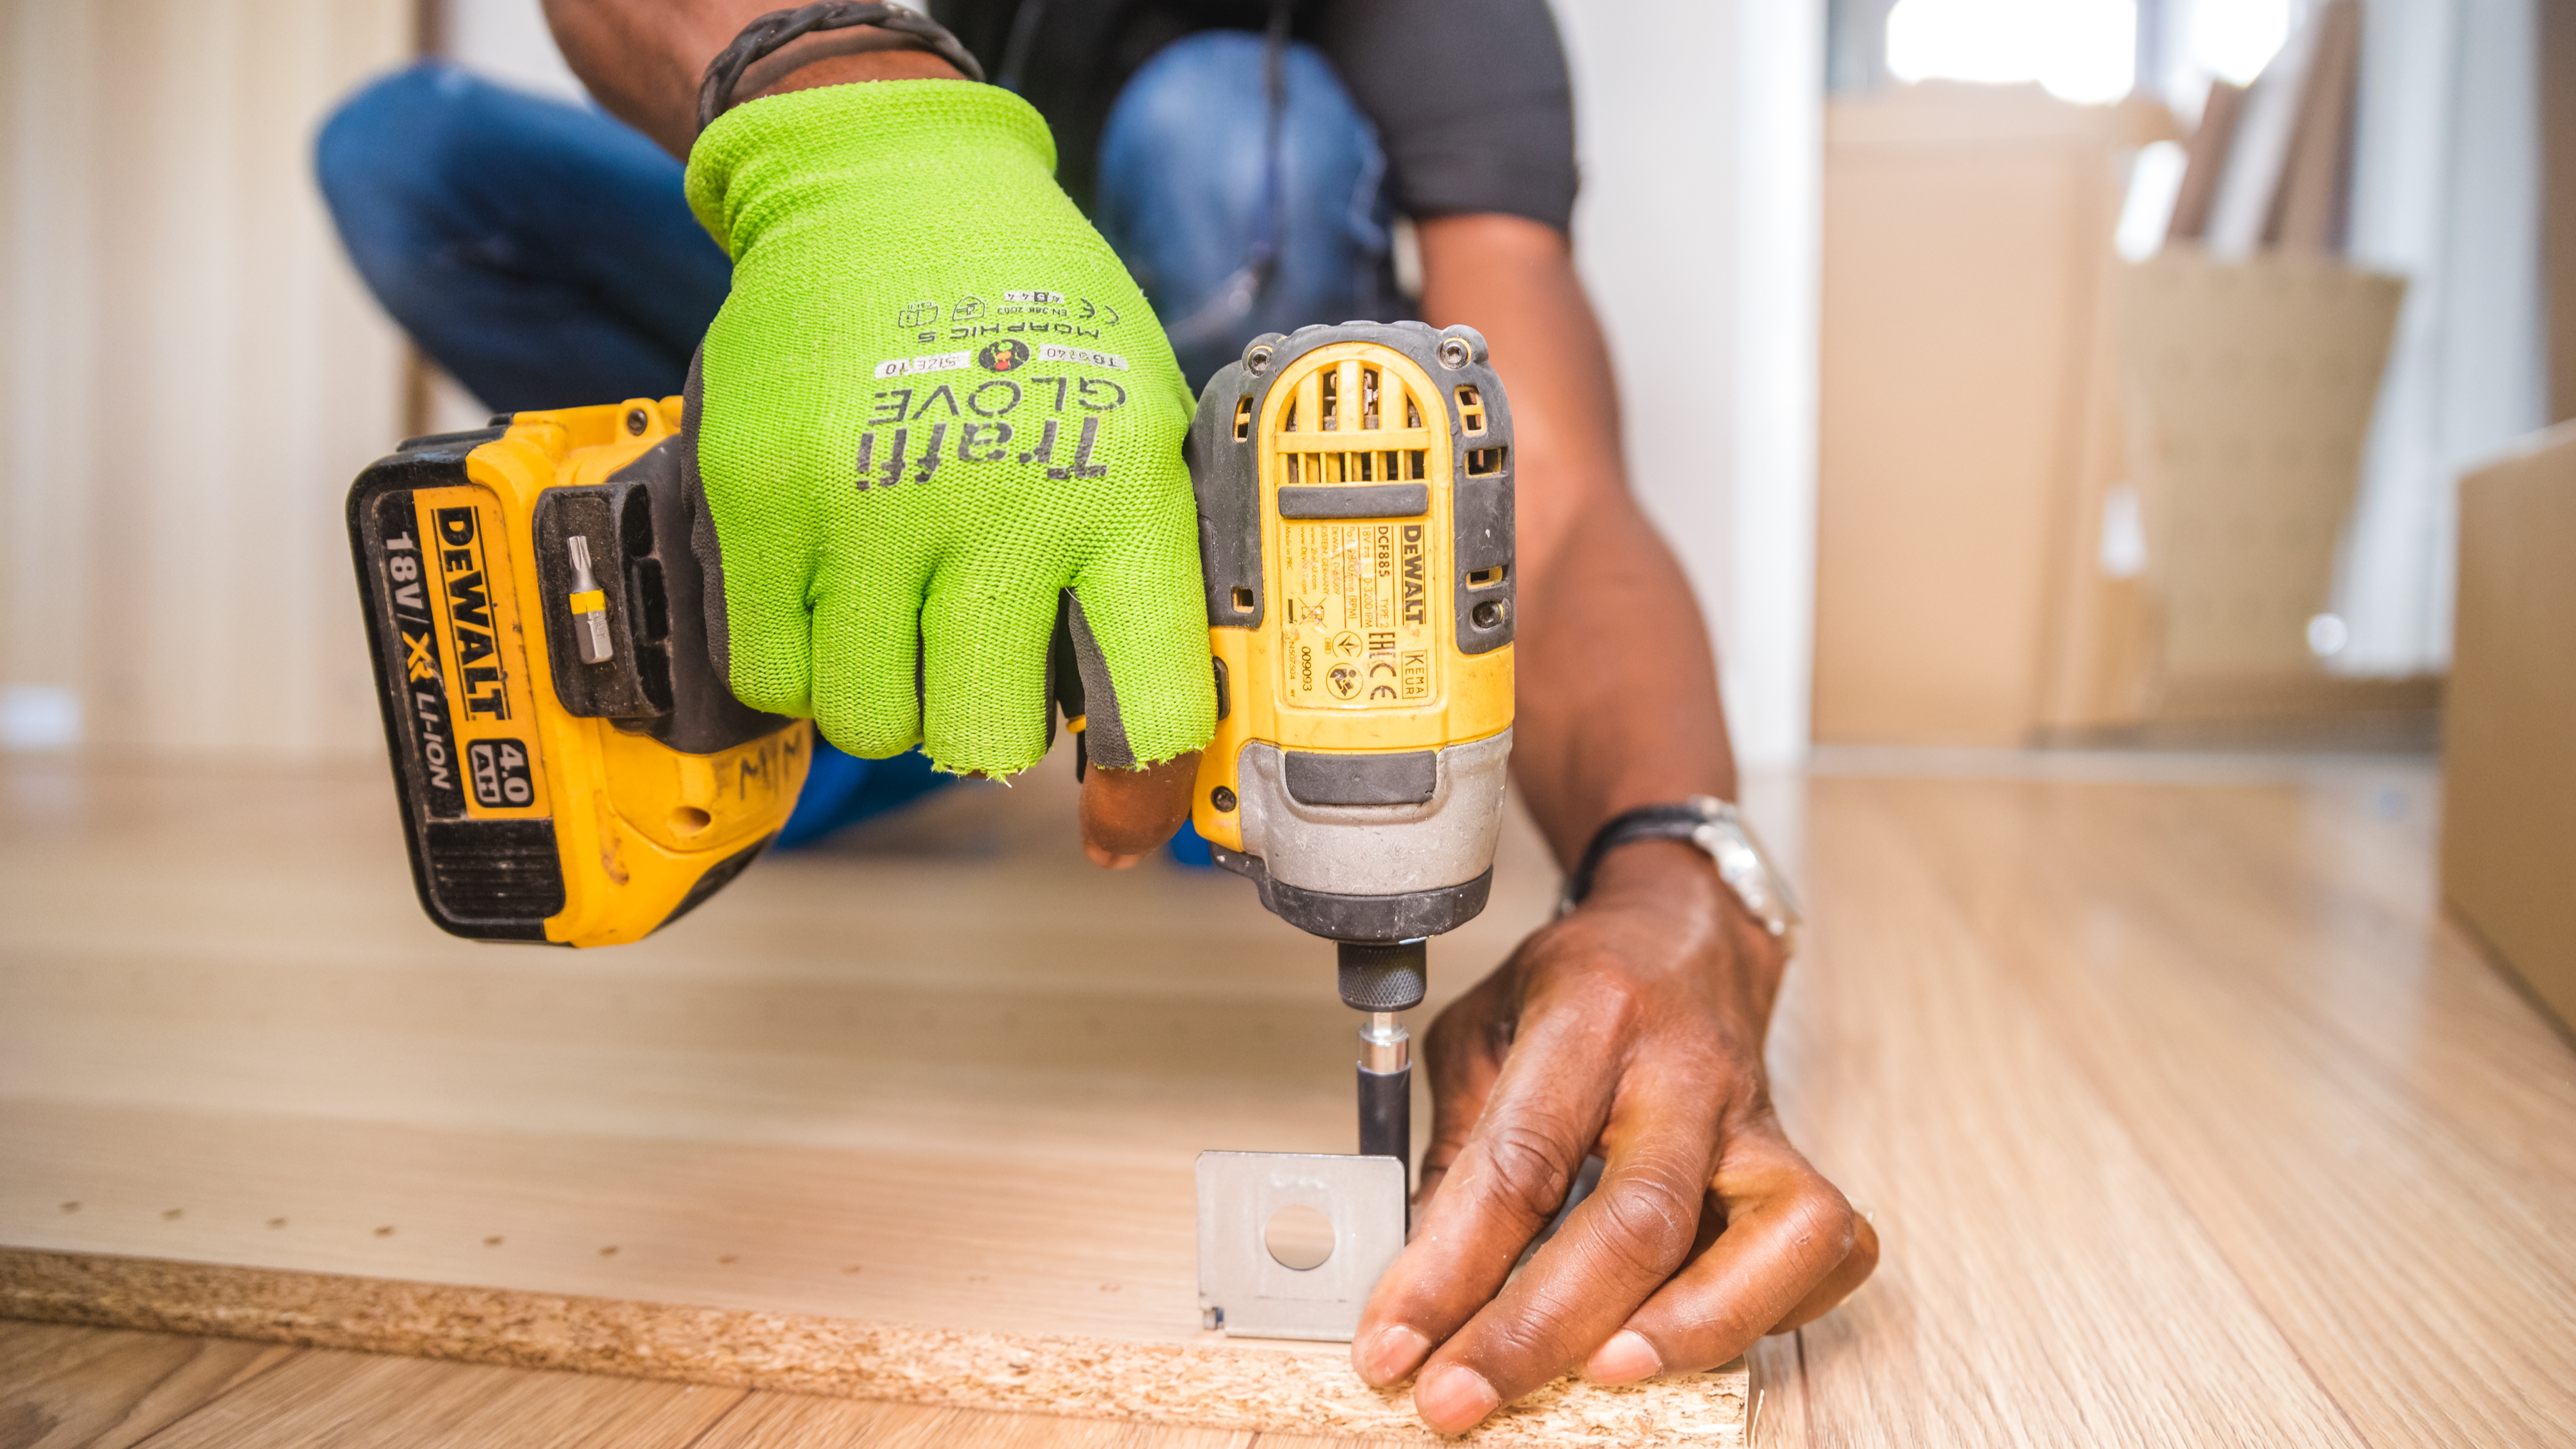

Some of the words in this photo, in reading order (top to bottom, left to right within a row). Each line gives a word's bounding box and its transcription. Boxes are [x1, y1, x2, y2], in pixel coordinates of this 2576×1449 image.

[886, 362, 910, 376] 10
[917, 356, 955, 371] SIZE
[868, 376, 1126, 426] GLOVE
[856, 417, 1108, 491] Traffi
[1378, 527, 1389, 577] DCF885
[1404, 525, 1423, 624] DEWALT
[436, 506, 505, 721] DEWALT
[1347, 595, 1357, 619] (RPM)
[1302, 646, 1312, 691] 009093
[1370, 663, 1396, 700] CE
[415, 692, 451, 790] LI-ION
[475, 750, 496, 798] AH
[498, 743, 531, 803] 4.0
